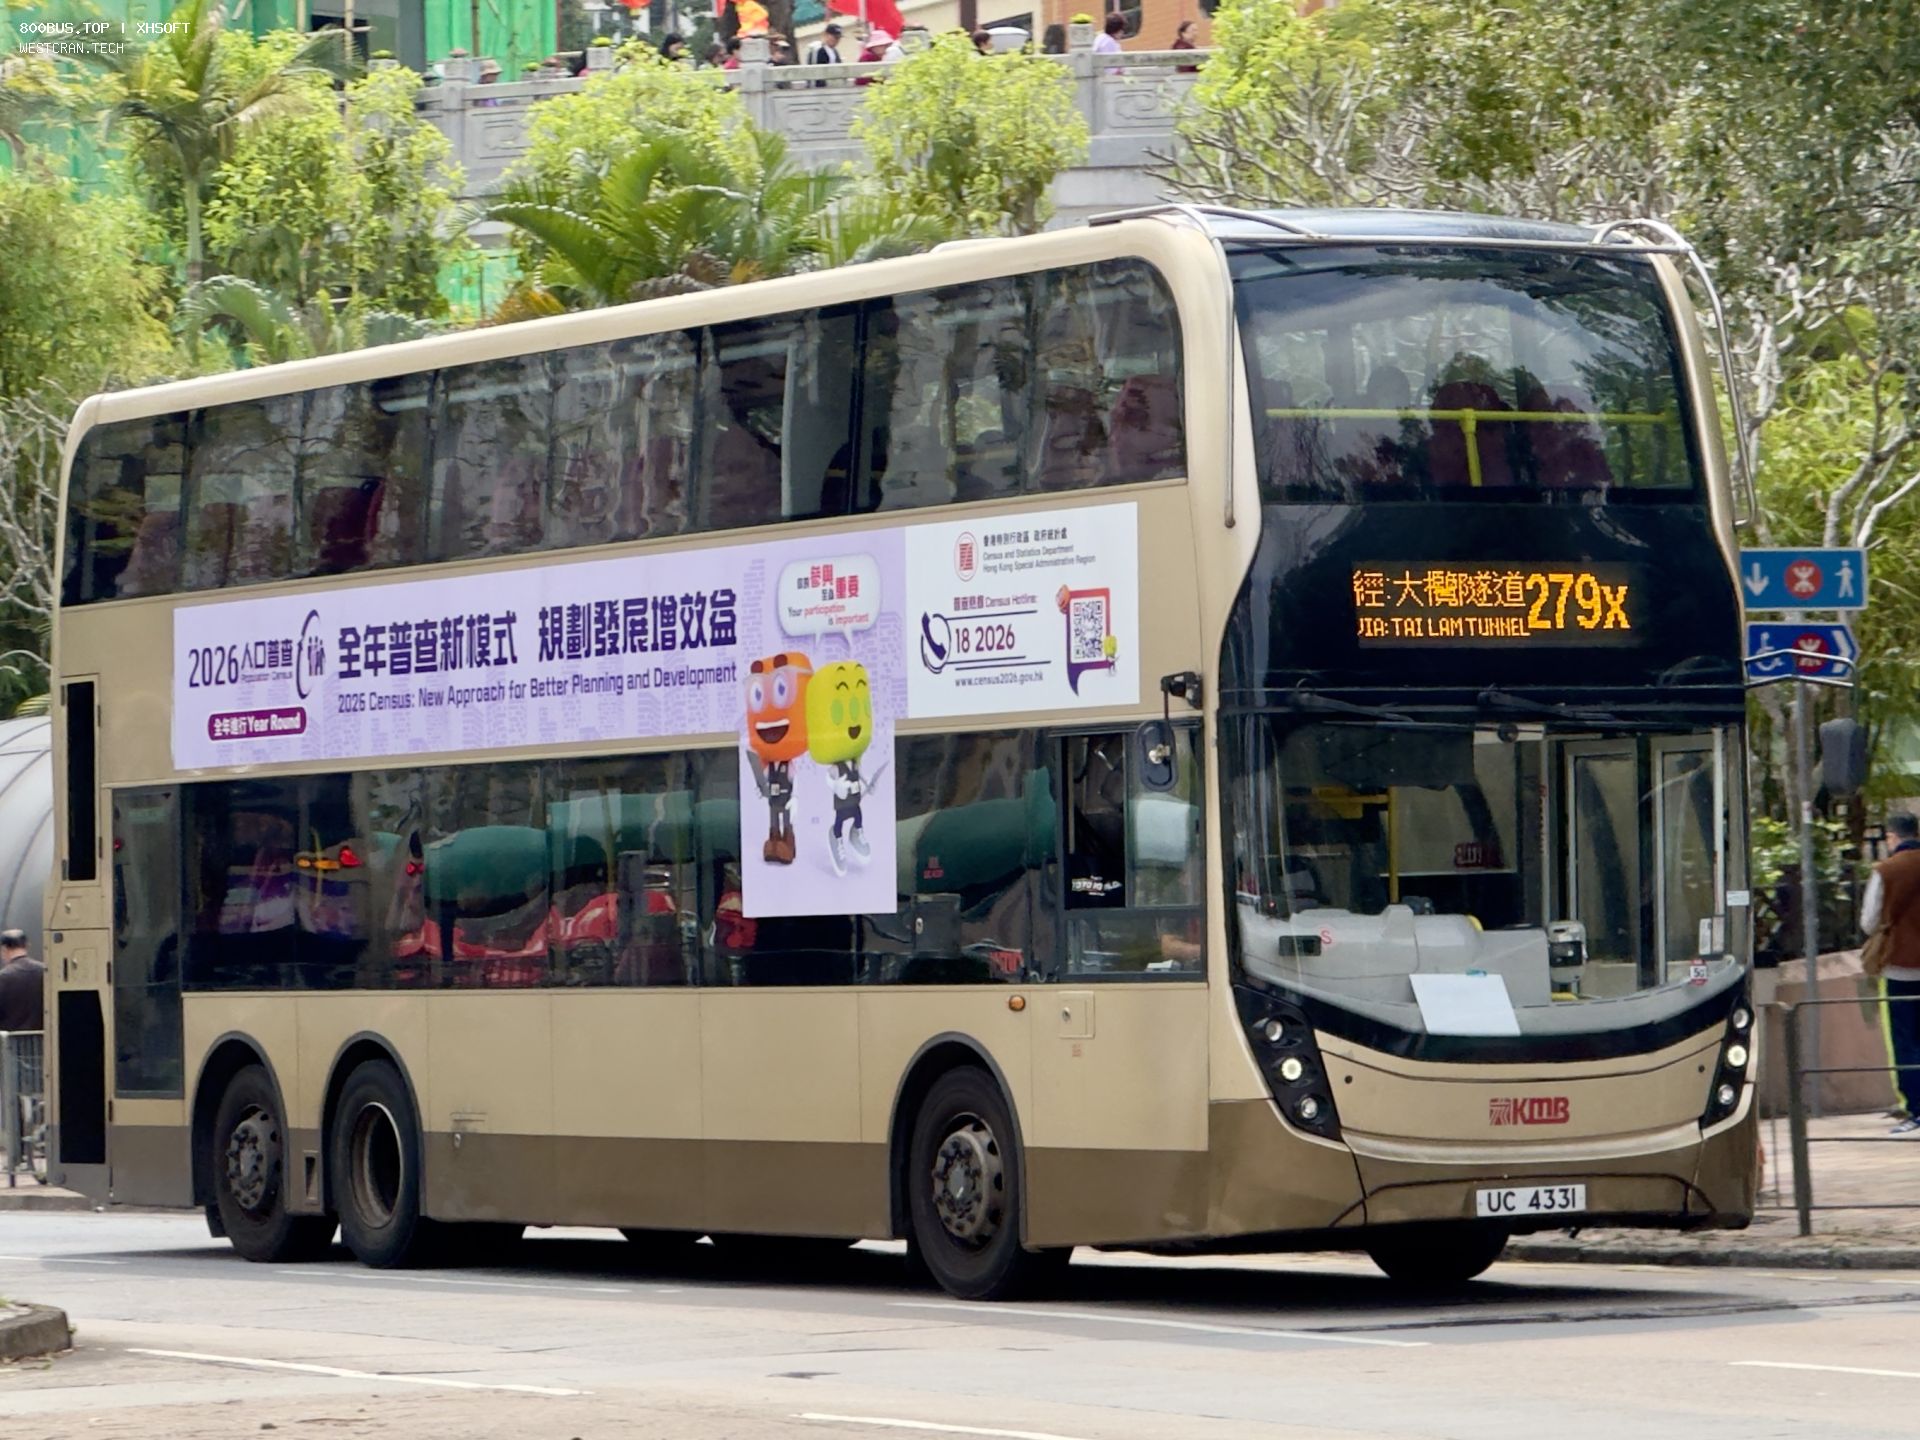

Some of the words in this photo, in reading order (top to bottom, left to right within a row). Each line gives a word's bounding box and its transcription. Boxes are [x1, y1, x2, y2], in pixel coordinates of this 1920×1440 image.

[983, 550, 1003, 561] Census
[1004, 549, 1015, 559] and
[1016, 546, 1041, 558] Statistics
[1042, 544, 1074, 556] Department
[983, 563, 998, 574] Hong
[999, 562, 1014, 573] Kong
[1014, 560, 1034, 571] Special
[1076, 554, 1096, 567] Region
[787, 606, 803, 618] Your
[804, 603, 846, 619] participation
[985, 596, 1011, 608] Census
[835, 612, 870, 627] important
[1427, 616, 1464, 637] LAM
[1464, 616, 1532, 637] TUNNEL
[338, 609, 519, 680] 全年普查新模式
[537, 588, 737, 664] 規劃發展增效益
[955, 627, 971, 654] 18
[974, 623, 1016, 653] 2026
[188, 644, 239, 688] 2026
[241, 638, 293, 670] 人口普查
[338, 692, 366, 714] 2026
[368, 690, 416, 712] Census:
[418, 687, 444, 708] New
[447, 680, 505, 710] Approach
[508, 678, 527, 700] for
[530, 675, 569, 698] Better
[571, 671, 624, 696] Planning
[626, 669, 650, 690] and
[653, 661, 737, 691] Development
[954, 671, 1044, 687] www.census2026.gov.hk
[247, 715, 269, 733] Year
[270, 711, 301, 731] Round
[1511, 1096, 1571, 1126] KMB
[1487, 1191, 1516, 1213] UC
[1528, 1187, 1577, 1211] 4331
